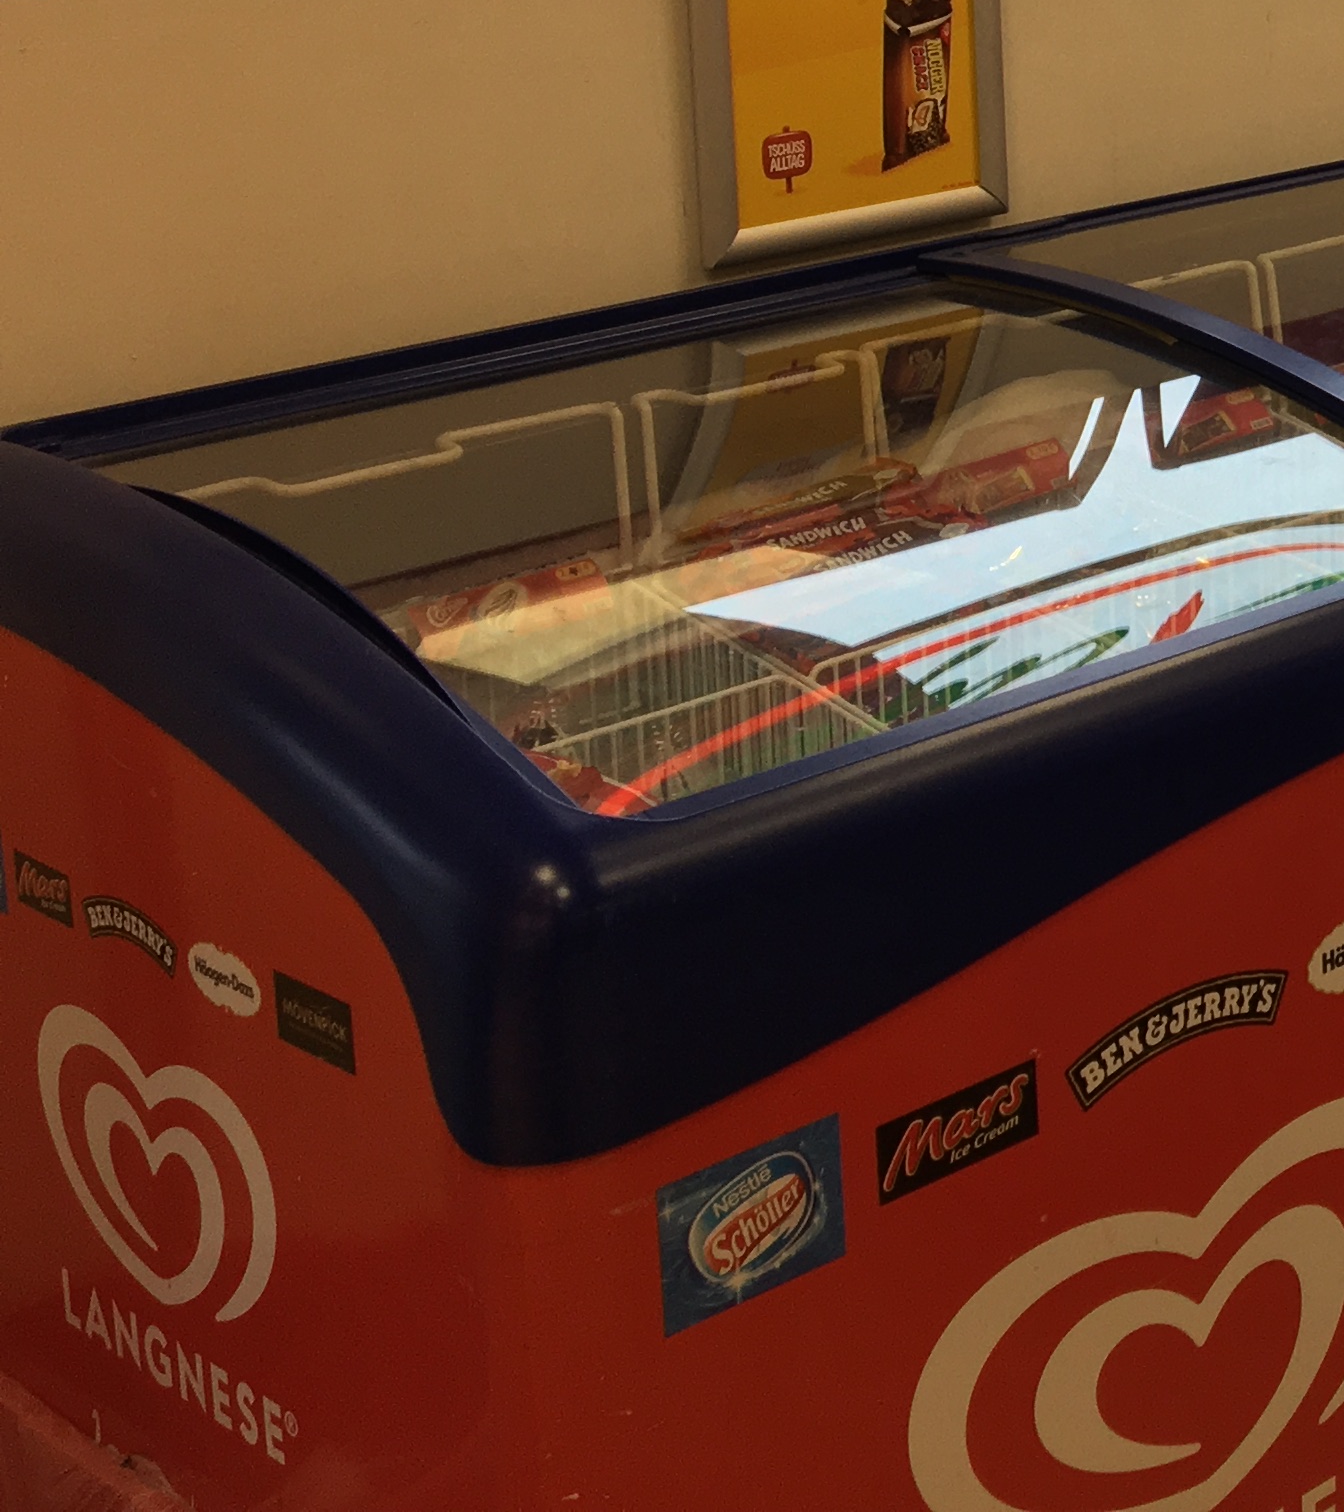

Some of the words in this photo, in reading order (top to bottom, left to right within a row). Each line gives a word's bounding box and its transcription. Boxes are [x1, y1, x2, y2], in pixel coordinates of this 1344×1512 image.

[767, 139, 806, 159] TSCHÜSS
[769, 152, 807, 174] ALLTAG
[766, 516, 867, 551] SANDWICH
[813, 530, 914, 573] SANDWICH
[18, 861, 70, 903] Mars
[883, 1072, 1029, 1193] Mars
[949, 1145, 970, 1165] Ice
[973, 1115, 1019, 1151] Cream
[712, 1163, 773, 1219] Nestlé
[709, 1178, 802, 1276] Schöller
